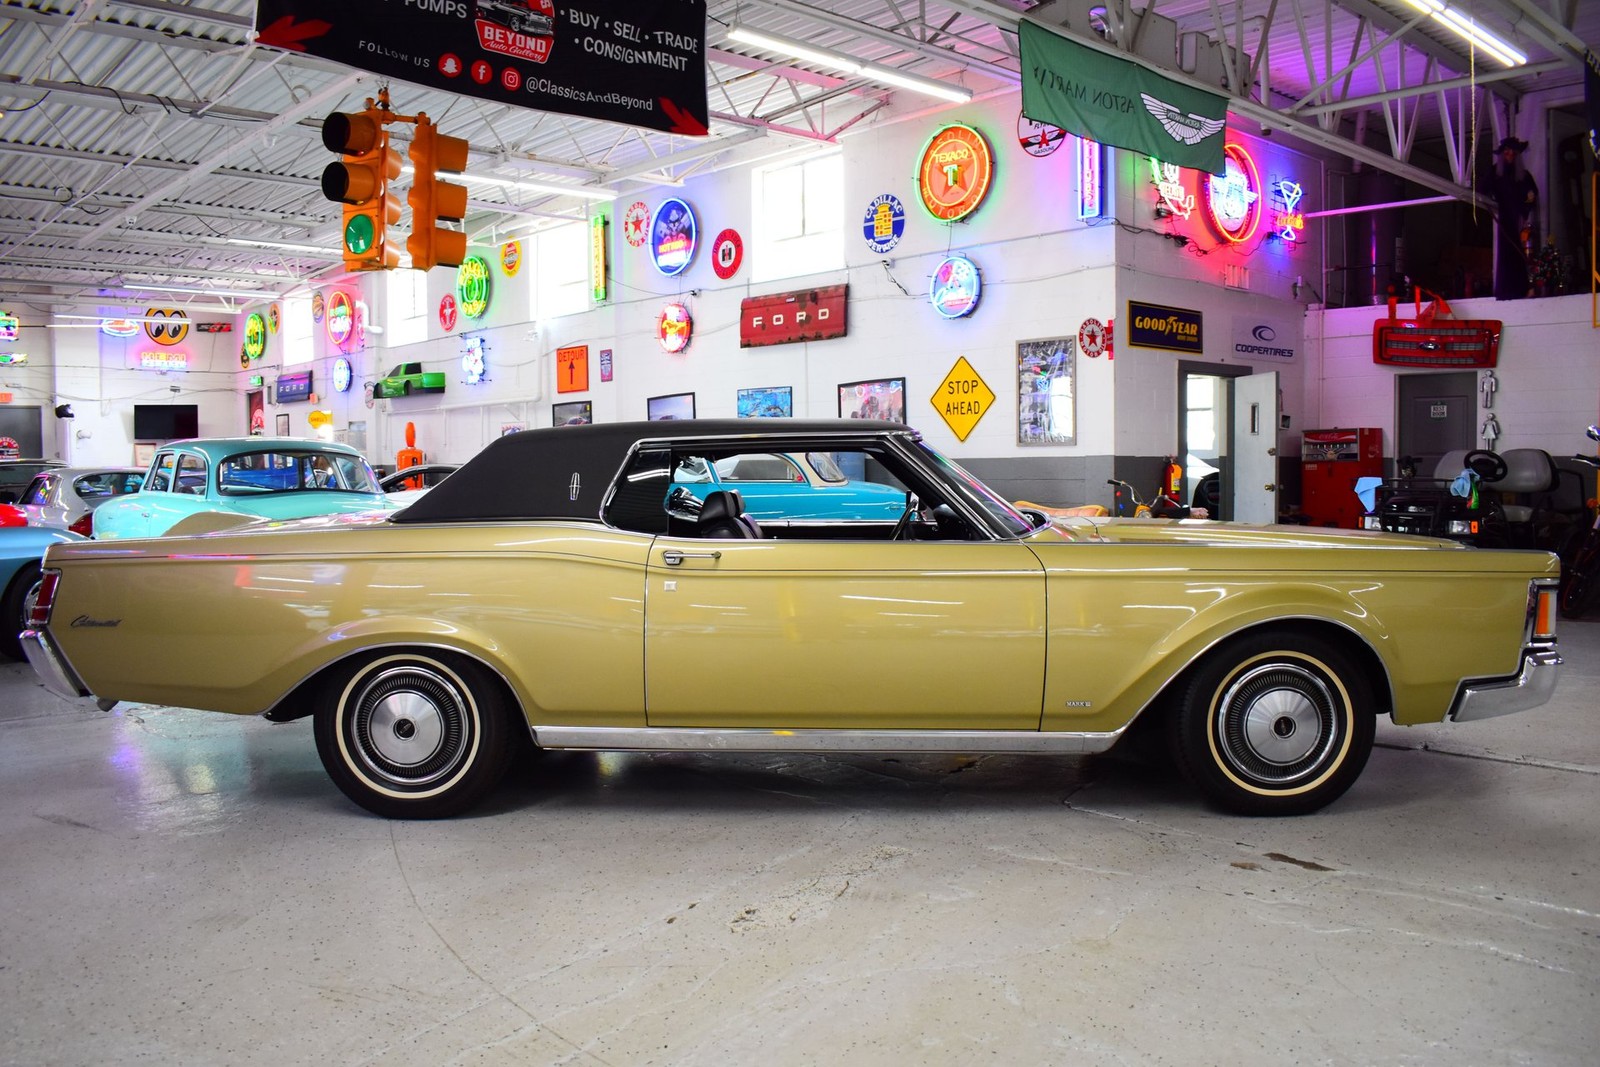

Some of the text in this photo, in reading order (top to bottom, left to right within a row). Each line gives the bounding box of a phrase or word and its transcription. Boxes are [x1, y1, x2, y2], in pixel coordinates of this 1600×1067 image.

[484, 25, 546, 53] BEYOND
[569, 8, 699, 53] BUY SELL TRADE
[358, 40, 430, 68] FOLLOW US
[485, 40, 544, 61] Auto Gallery
[583, 37, 688, 71] CONSIGNMENT
[526, 76, 653, 111] @ClassicsAndBeyond
[934, 149, 969, 164] TEXACO
[1033, 146, 1055, 156] GASOLINE
[865, 194, 903, 219] CADILLAC
[922, 187, 966, 219] MOTOR
[864, 233, 899, 252] SERVICE
[753, 308, 830, 328] FORD
[1135, 316, 1198, 336] GOODYEAR
[558, 349, 585, 363] DETOUR
[1235, 344, 1294, 358] COOPERTIRES
[280, 384, 305, 393] FORD
[947, 380, 979, 395] STOP
[945, 401, 980, 415] AHEAD
